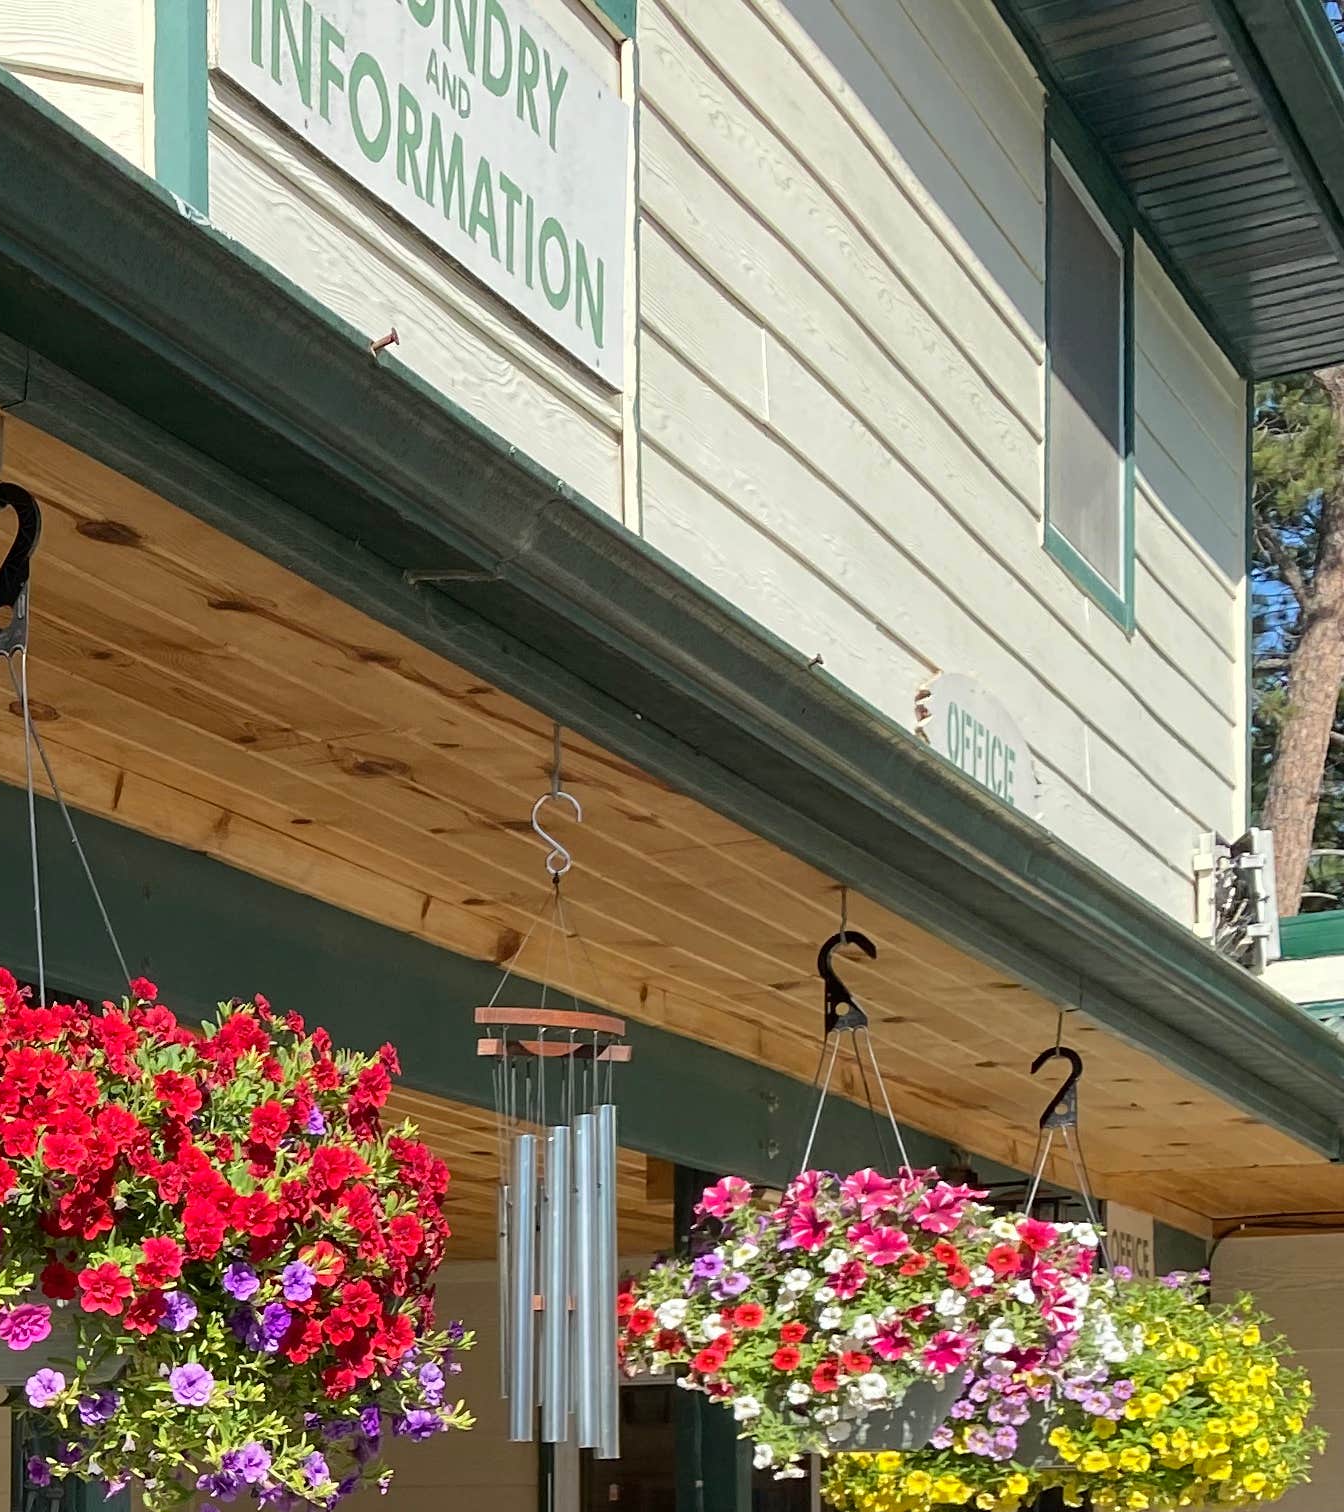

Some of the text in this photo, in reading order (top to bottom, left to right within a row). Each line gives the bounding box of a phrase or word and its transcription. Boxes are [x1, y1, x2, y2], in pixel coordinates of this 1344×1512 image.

[408, 0, 568, 153] NDRY
[426, 48, 471, 119] AND
[251, 0, 604, 350] INFORMATION
[947, 701, 1015, 807] OFFICE
